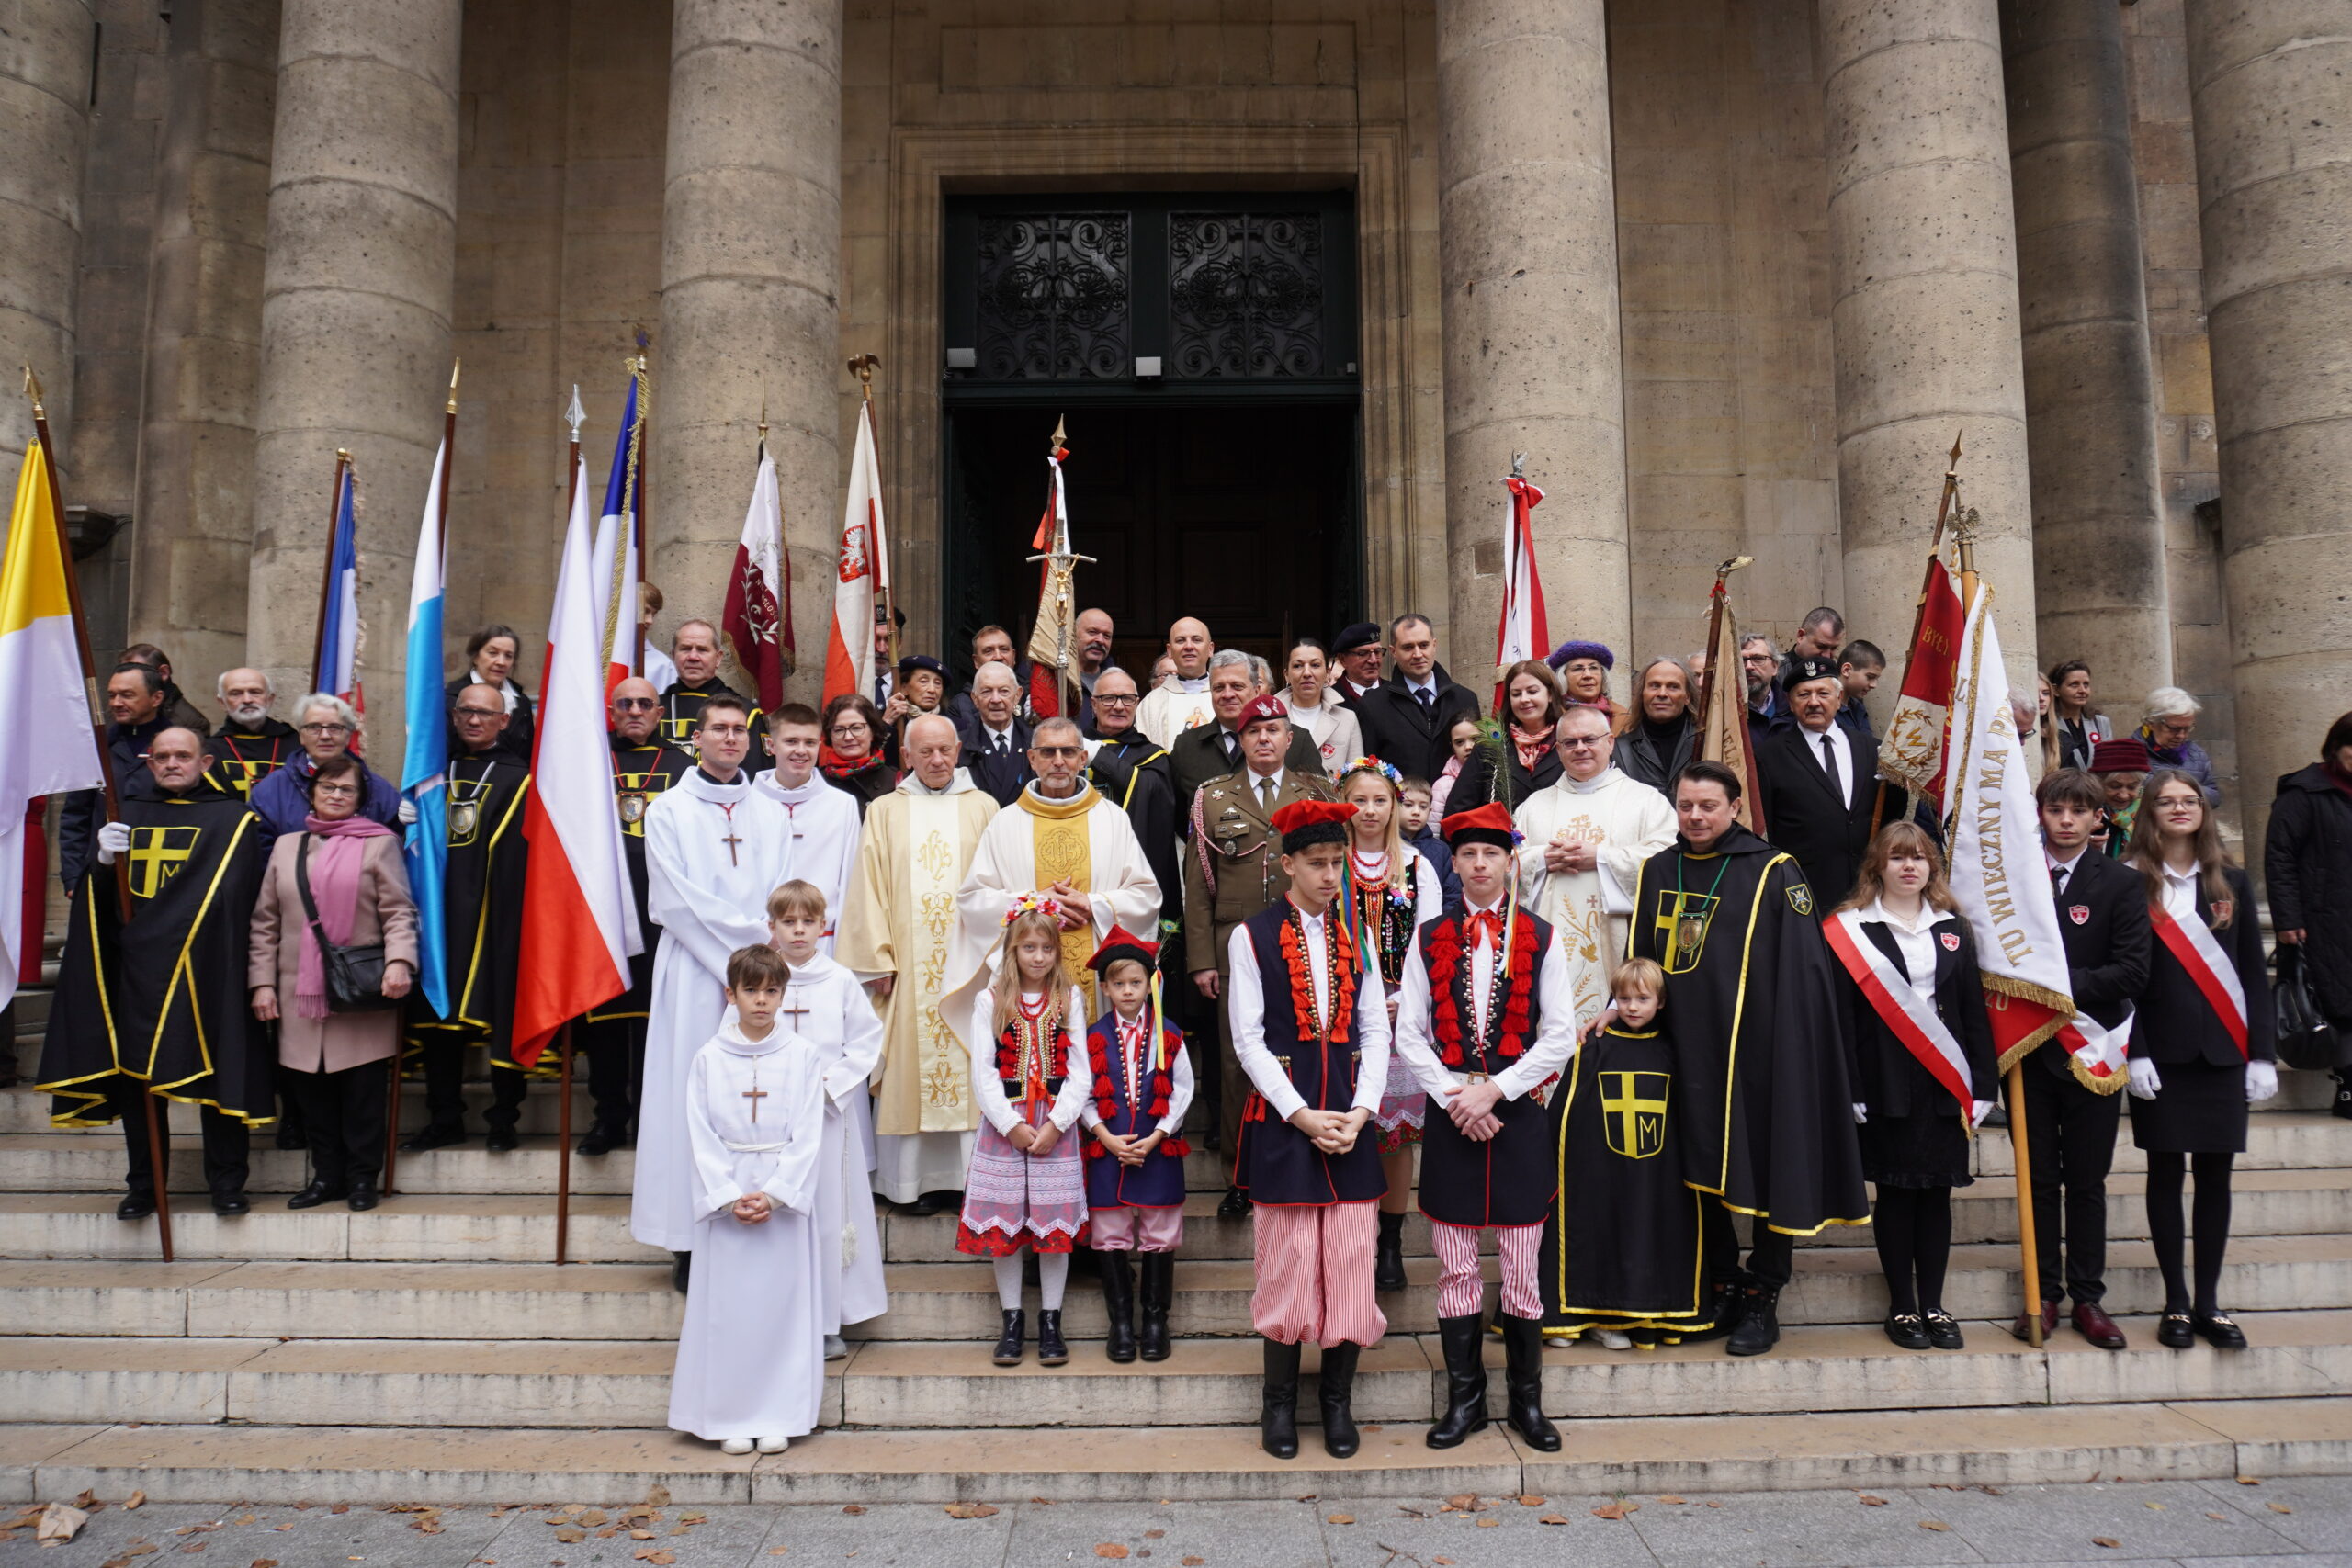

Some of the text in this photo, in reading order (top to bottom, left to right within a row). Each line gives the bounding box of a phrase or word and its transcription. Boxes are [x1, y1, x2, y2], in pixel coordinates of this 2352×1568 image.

[1977, 698, 2033, 967] TU WIECZNY MA PR
[160, 863, 180, 889] M
[1639, 1115, 1657, 1150] M
